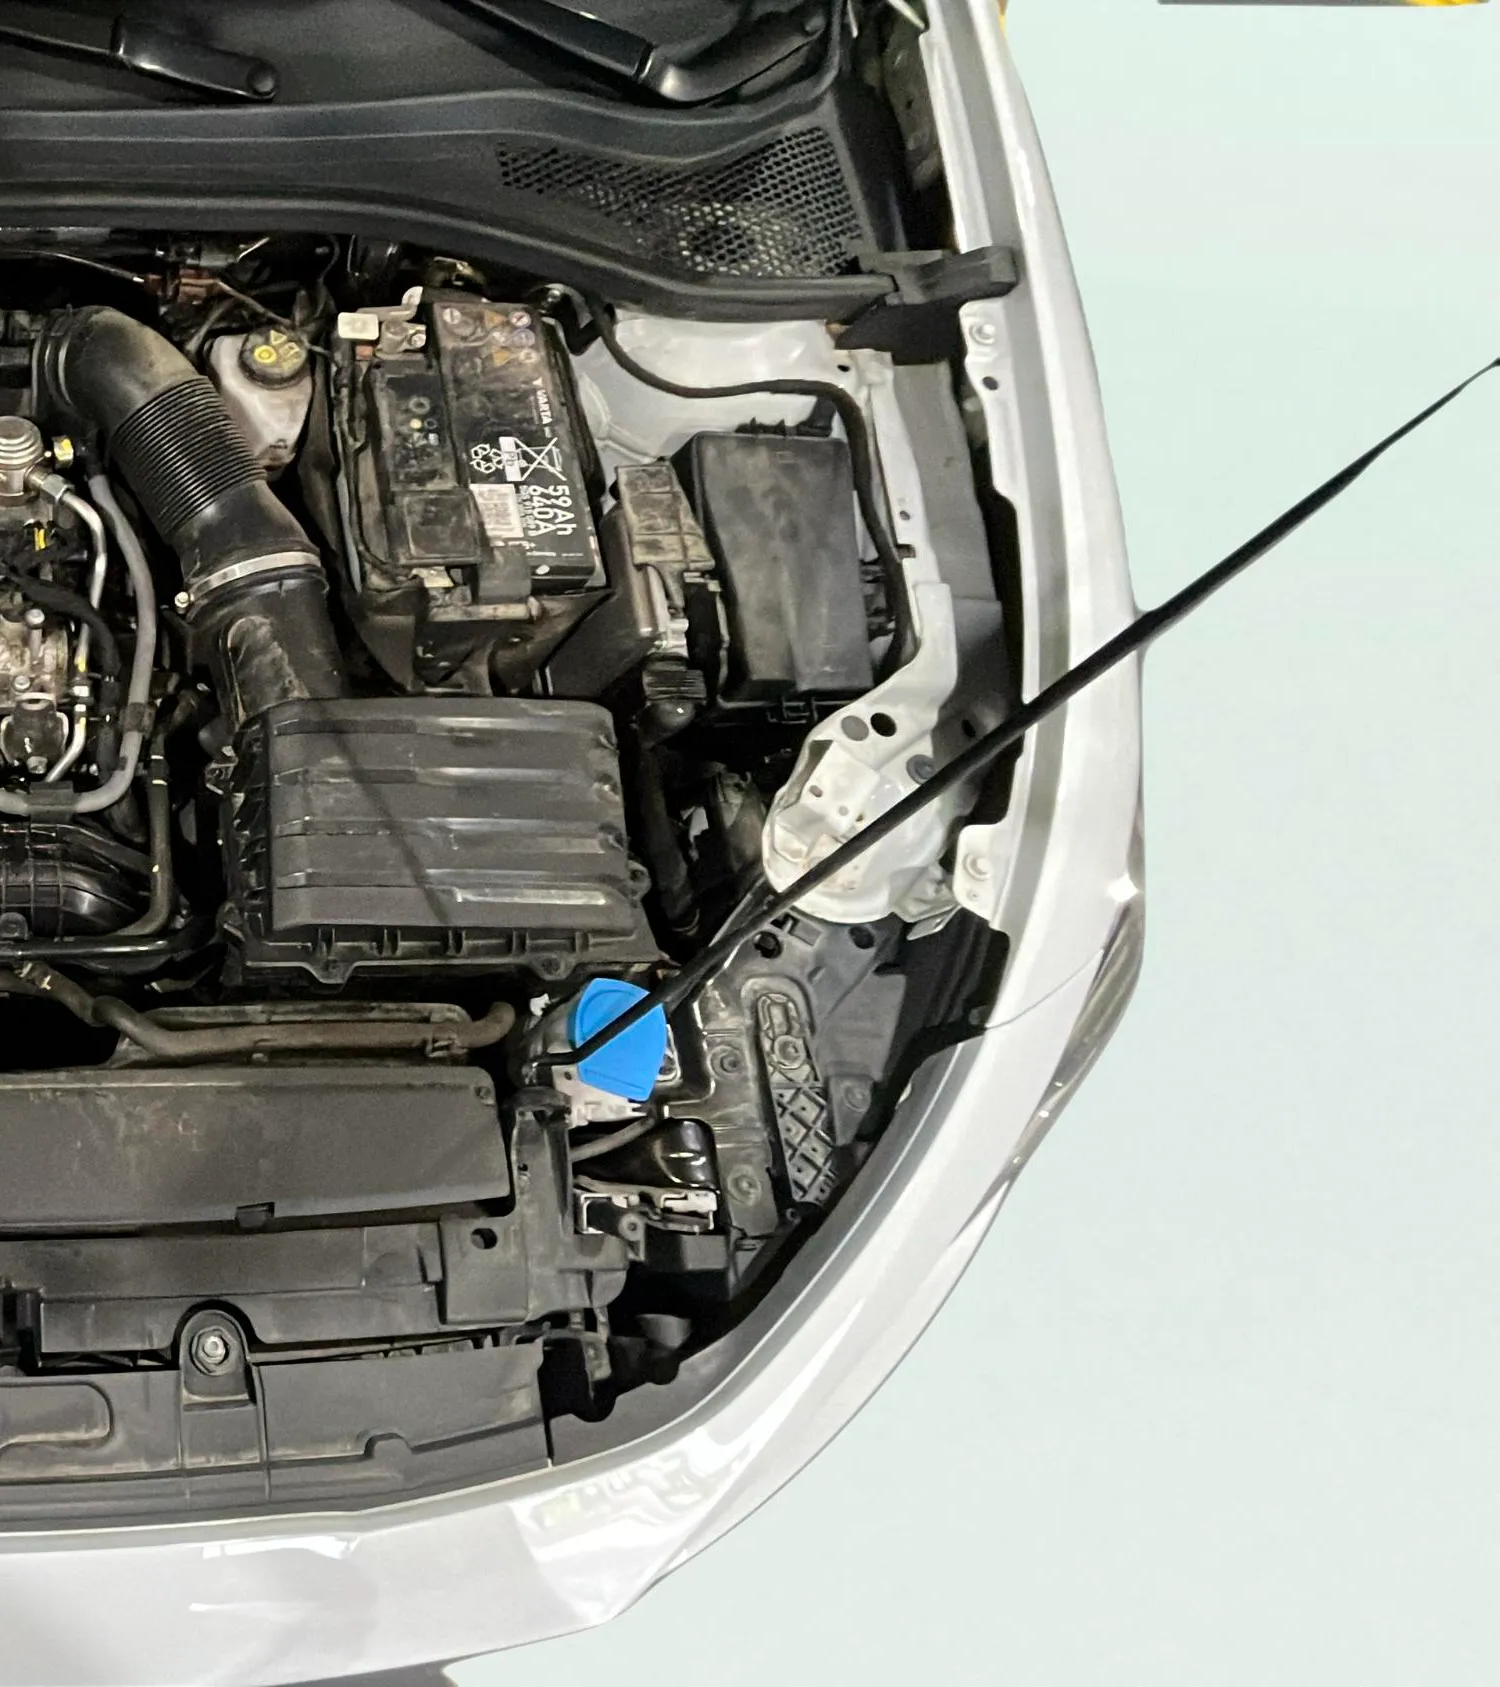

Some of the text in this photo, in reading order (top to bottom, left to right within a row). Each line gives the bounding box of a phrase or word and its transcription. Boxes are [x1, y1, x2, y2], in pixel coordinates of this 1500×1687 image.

[537, 389, 553, 425] VARTA
[504, 451, 518, 467] Pb
[528, 485, 557, 537] 640A
[549, 485, 577, 536] 59Ah
